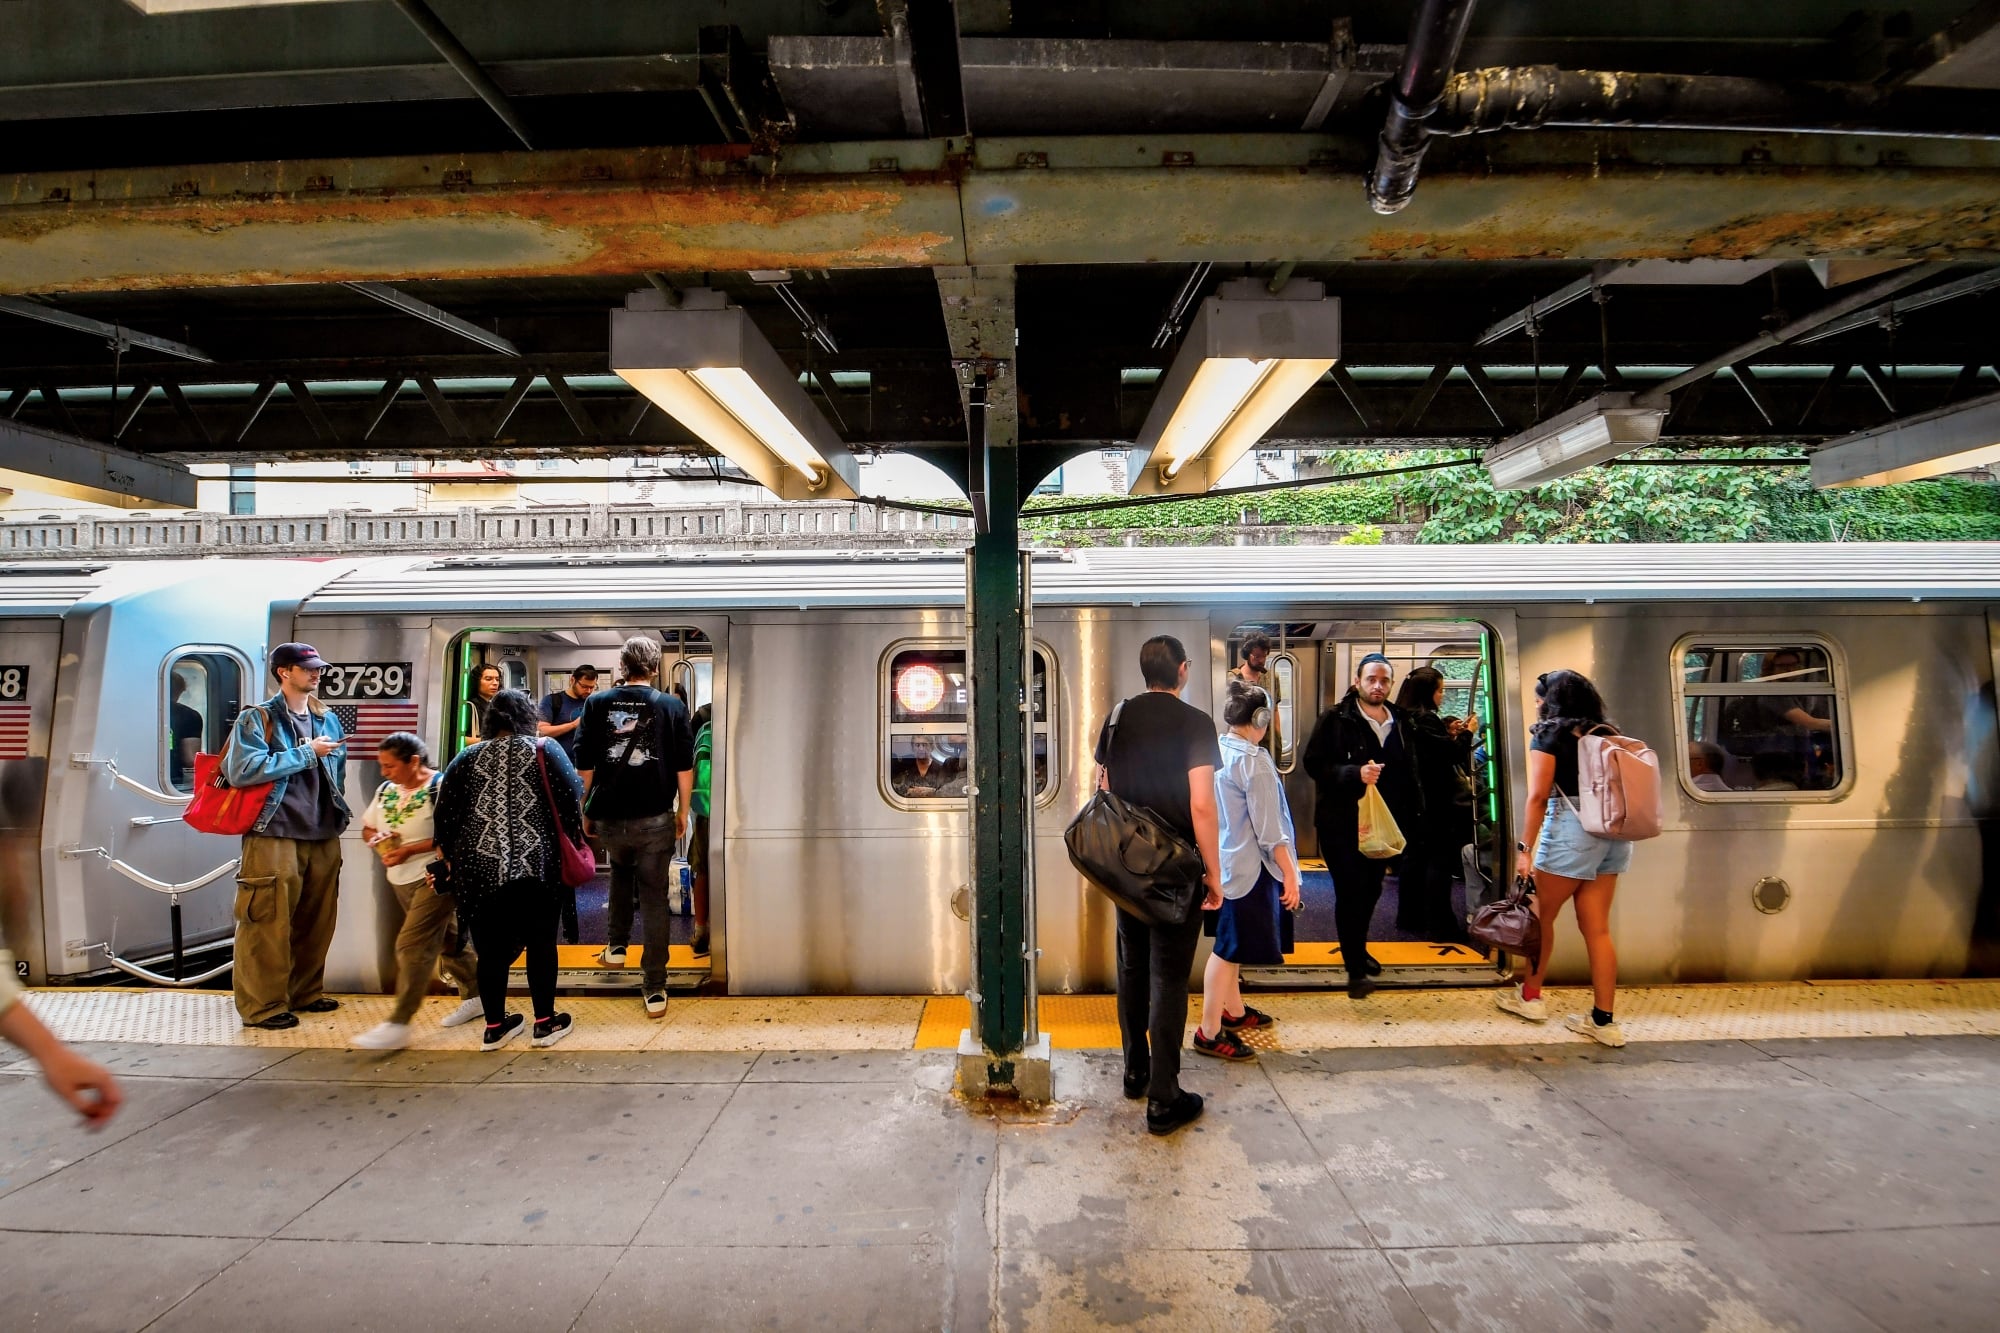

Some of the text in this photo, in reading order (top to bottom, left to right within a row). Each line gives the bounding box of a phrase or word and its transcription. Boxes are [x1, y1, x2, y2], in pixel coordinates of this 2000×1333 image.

[0, 668, 20, 697] 8
[325, 666, 404, 696] 3739
[909, 672, 935, 704] B
[18, 961, 27, 976] 2
